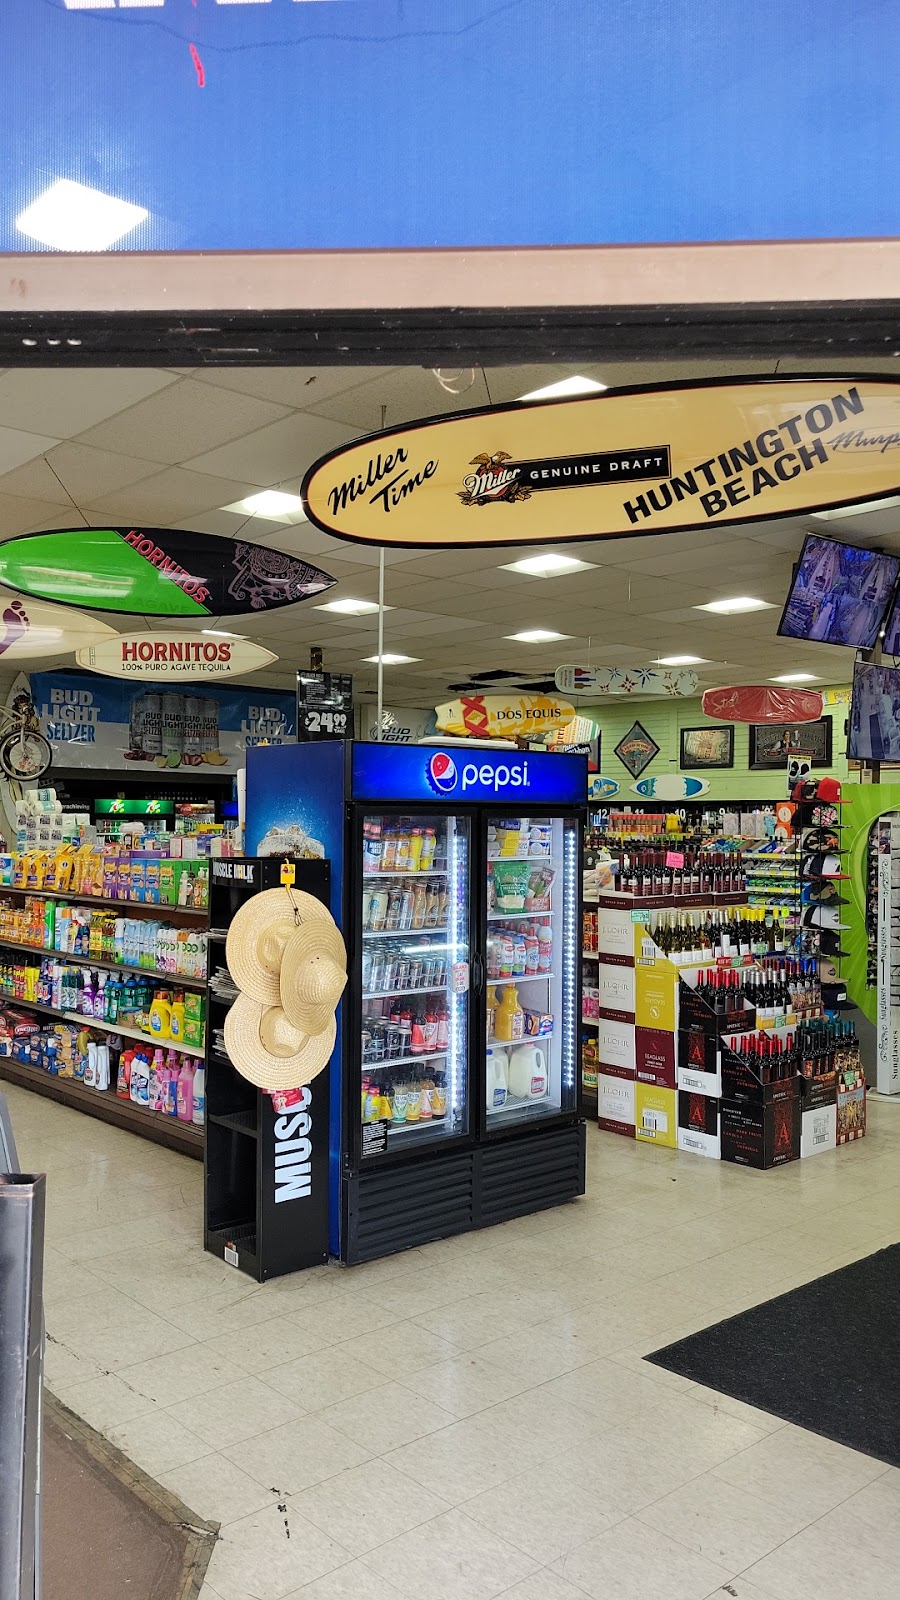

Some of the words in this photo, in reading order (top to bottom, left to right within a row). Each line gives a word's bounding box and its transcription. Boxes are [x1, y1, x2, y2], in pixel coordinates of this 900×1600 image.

[826, 430, 900, 453] Murp
[623, 387, 865, 525] HUNTINGTON
[530, 464, 601, 480] GENUINE
[609, 456, 664, 473] DRAFT
[327, 448, 409, 516] Miller
[368, 458, 440, 513] Time
[462, 467, 523, 499] Miller
[702, 438, 830, 519] BEACH
[124, 530, 212, 604] HORNITOS
[121, 641, 232, 662] HORNITOS
[121, 663, 143, 671] 100%
[145, 663, 169, 671] PURO
[170, 663, 196, 671] AGAVE
[198, 663, 232, 673] TEQUILA
[50, 688, 94, 707] BUD
[41, 704, 101, 723] LIGHT
[145, 711, 161, 720] BUD
[164, 713, 182, 722] BUD
[184, 715, 201, 723] BUD
[203, 716, 217, 724] BUD
[248, 705, 281, 722] BUD
[497, 709, 523, 721] DOS
[525, 707, 562, 720] EQUIS
[46, 721, 96, 743] SELTZER
[374, 734, 413, 742] IGHT
[462, 760, 528, 792] pepsi
[597, 808, 608, 819] 12
[675, 808, 686, 819] 10
[213, 860, 233, 879] MUSCLE
[880, 987, 888, 1021] Sunglasses
[691, 1045, 703, 1060] A
[891, 1030, 899, 1080] Sunglasses
[777, 1121, 790, 1147] A
